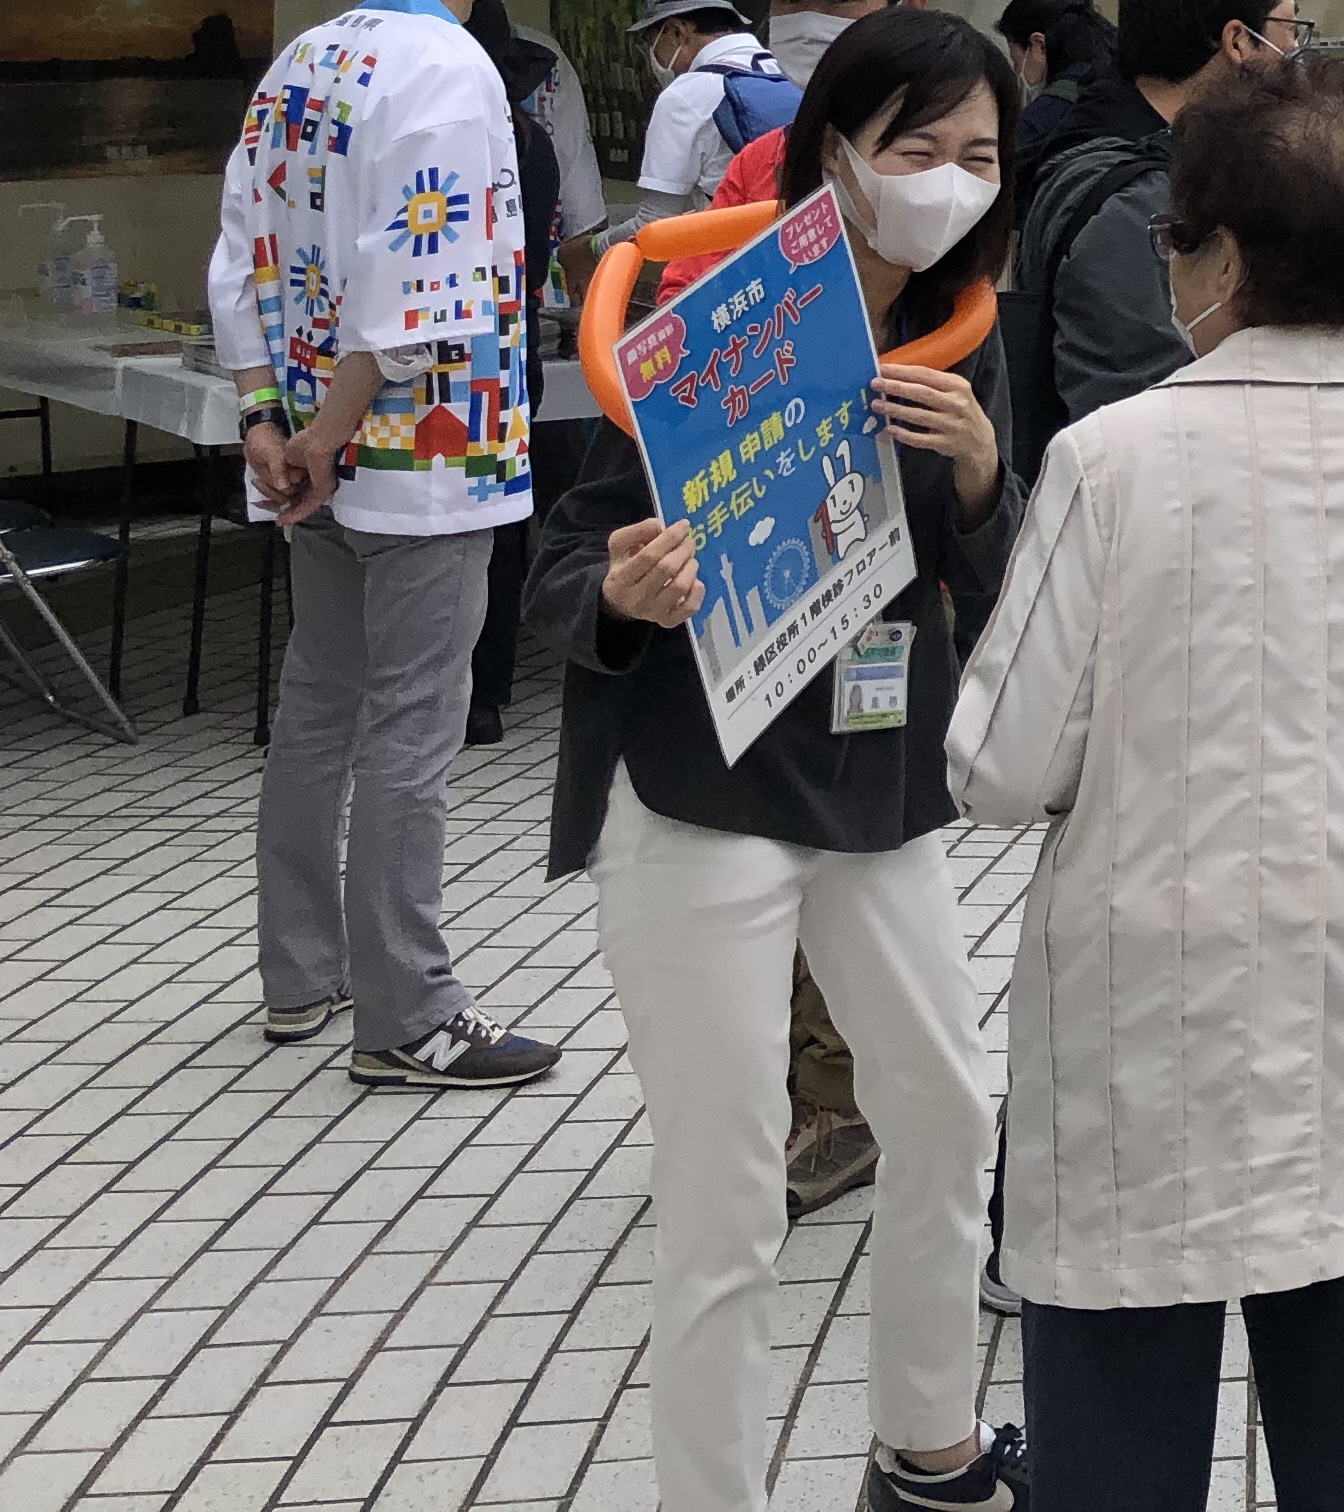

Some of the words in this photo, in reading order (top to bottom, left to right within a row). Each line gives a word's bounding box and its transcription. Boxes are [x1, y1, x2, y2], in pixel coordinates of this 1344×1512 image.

[785, 201, 830, 240] プレゼント
[803, 237, 829, 263] います
[711, 277, 766, 333] 横浜市
[639, 345, 673, 383] 無料
[670, 284, 823, 408] マイナンバー
[721, 340, 797, 427] カード
